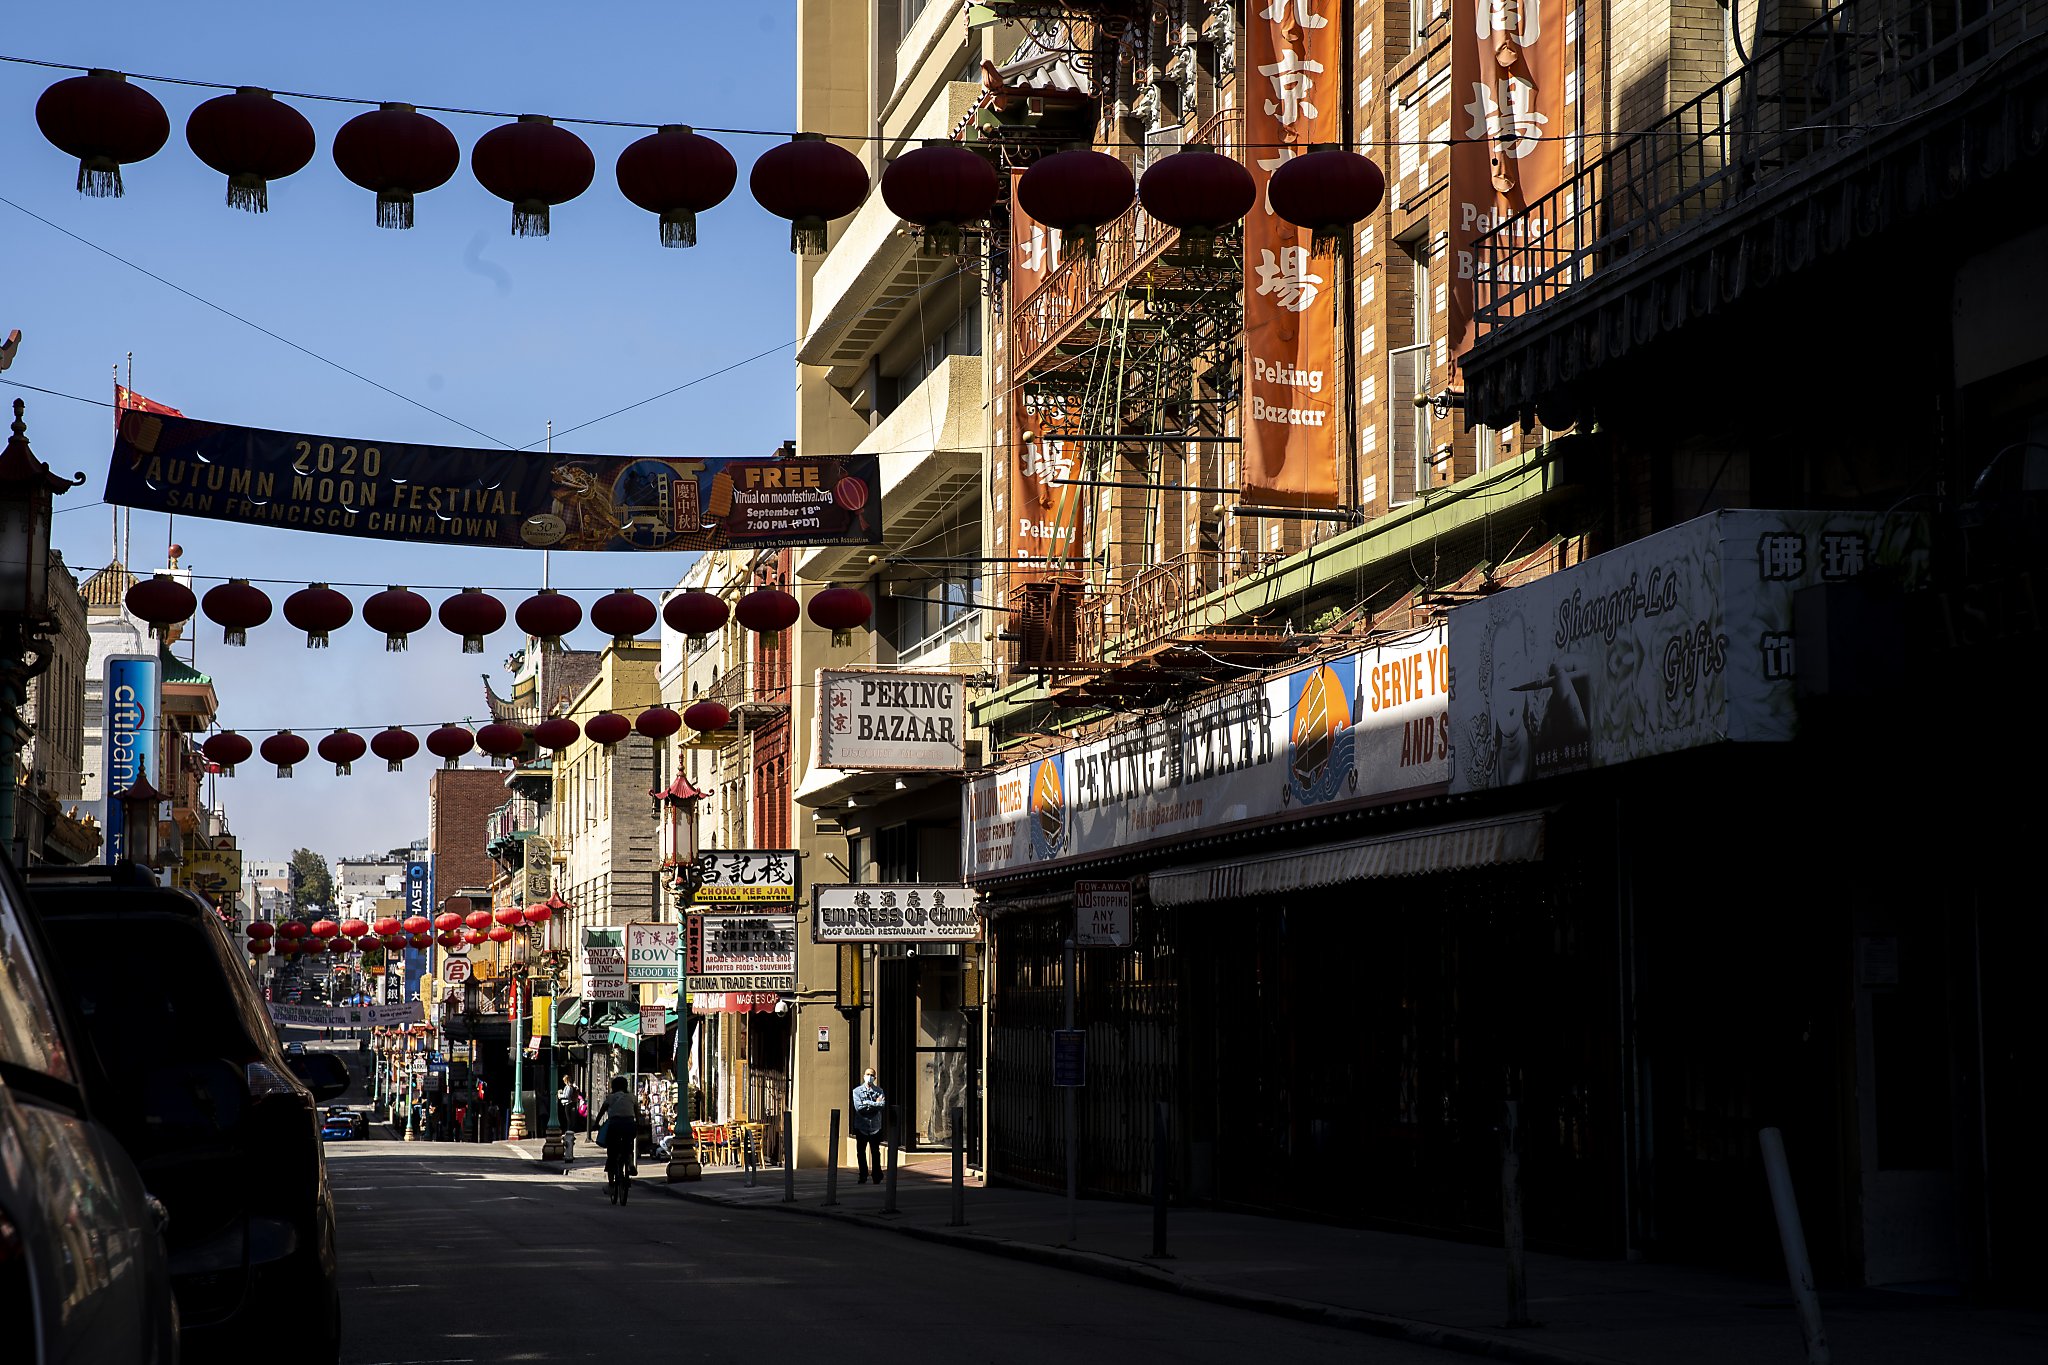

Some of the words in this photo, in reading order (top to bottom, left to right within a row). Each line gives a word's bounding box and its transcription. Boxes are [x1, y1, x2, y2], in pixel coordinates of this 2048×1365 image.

[1255, 0, 1329, 312] 京場
[1254, 357, 1323, 393] Peking
[1253, 396, 1326, 427] Bazaar
[294, 440, 382, 477] 2020
[145, 455, 275, 499] AUTUMN
[291, 475, 378, 508] MOON
[392, 483, 523, 517] FESTIVAL
[745, 466, 821, 489] FREE
[676, 483, 691, 530] 慶中秋
[734, 490, 759, 504] Virtual
[760, 493, 770, 503] on
[771, 489, 833, 505] moonfestival.org
[166, 488, 213, 513] SAN
[225, 497, 358, 530] FRANCISCO
[368, 511, 499, 539] CHINATOWN
[747, 507, 799, 519] September
[800, 505, 821, 516] 18th
[747, 520, 770, 530] 7:00
[771, 519, 788, 530] PM
[1019, 518, 1077, 544] Peking
[778, 538, 807, 547] Chinatown
[809, 537, 839, 545] Merchants
[1555, 567, 1678, 648] Shangri-La
[1663, 620, 1730, 701] Gifts
[1371, 652, 1423, 712] SERVE
[1427, 644, 1449, 696] YO
[860, 681, 953, 709] PEKING
[832, 692, 848, 732] 北京
[857, 714, 956, 743] BAZAAR
[113, 685, 141, 796] citibank
[1400, 715, 1435, 768] AND
[1075, 735, 1154, 811] PEKING
[984, 787, 998, 817] LOW
[999, 779, 1022, 815] PRICES
[1131, 799, 1203, 832] PekingBazaar.com
[992, 823, 1006, 840] FROM
[1007, 820, 1016, 837] THE
[995, 845, 1002, 861] TO
[1003, 843, 1013, 860] YOU
[700, 887, 737, 896] CHONG
[742, 887, 762, 895] KEE
[767, 887, 788, 895] JAN
[1078, 881, 1127, 891] TOW-AWAY
[411, 880, 423, 917] HASE
[1077, 892, 1091, 908] NO
[1092, 895, 1129, 908] STOPPING
[721, 919, 769, 930] CHINESE
[820, 907, 903, 927] EMPRESS
[904, 907, 928, 926] OF
[928, 906, 980, 926] CHINA
[1093, 910, 1114, 921] ANY
[713, 930, 788, 941] FURNITURE
[821, 927, 842, 936] ROOF
[844, 927, 875, 936] GARDEN
[878, 928, 927, 936] RESTAURANT
[937, 927, 979, 936] COCKTAILS
[588, 949, 611, 957] ONLY
[631, 948, 669, 961] BOW
[711, 941, 787, 953] EXHIBITION
[583, 957, 625, 965] CHINATOWN
[730, 955, 750, 963] SHOPS
[776, 955, 792, 963] SHOP
[759, 963, 792, 971] SOUVENIRS
[597, 965, 614, 973] INC.
[629, 967, 663, 977] SEAFOOD
[587, 979, 613, 988] GIFTS
[689, 977, 720, 991] CHINA
[720, 977, 753, 990] TRADE
[754, 976, 793, 990] CENTER
[586, 990, 625, 998] SOUVENIR
